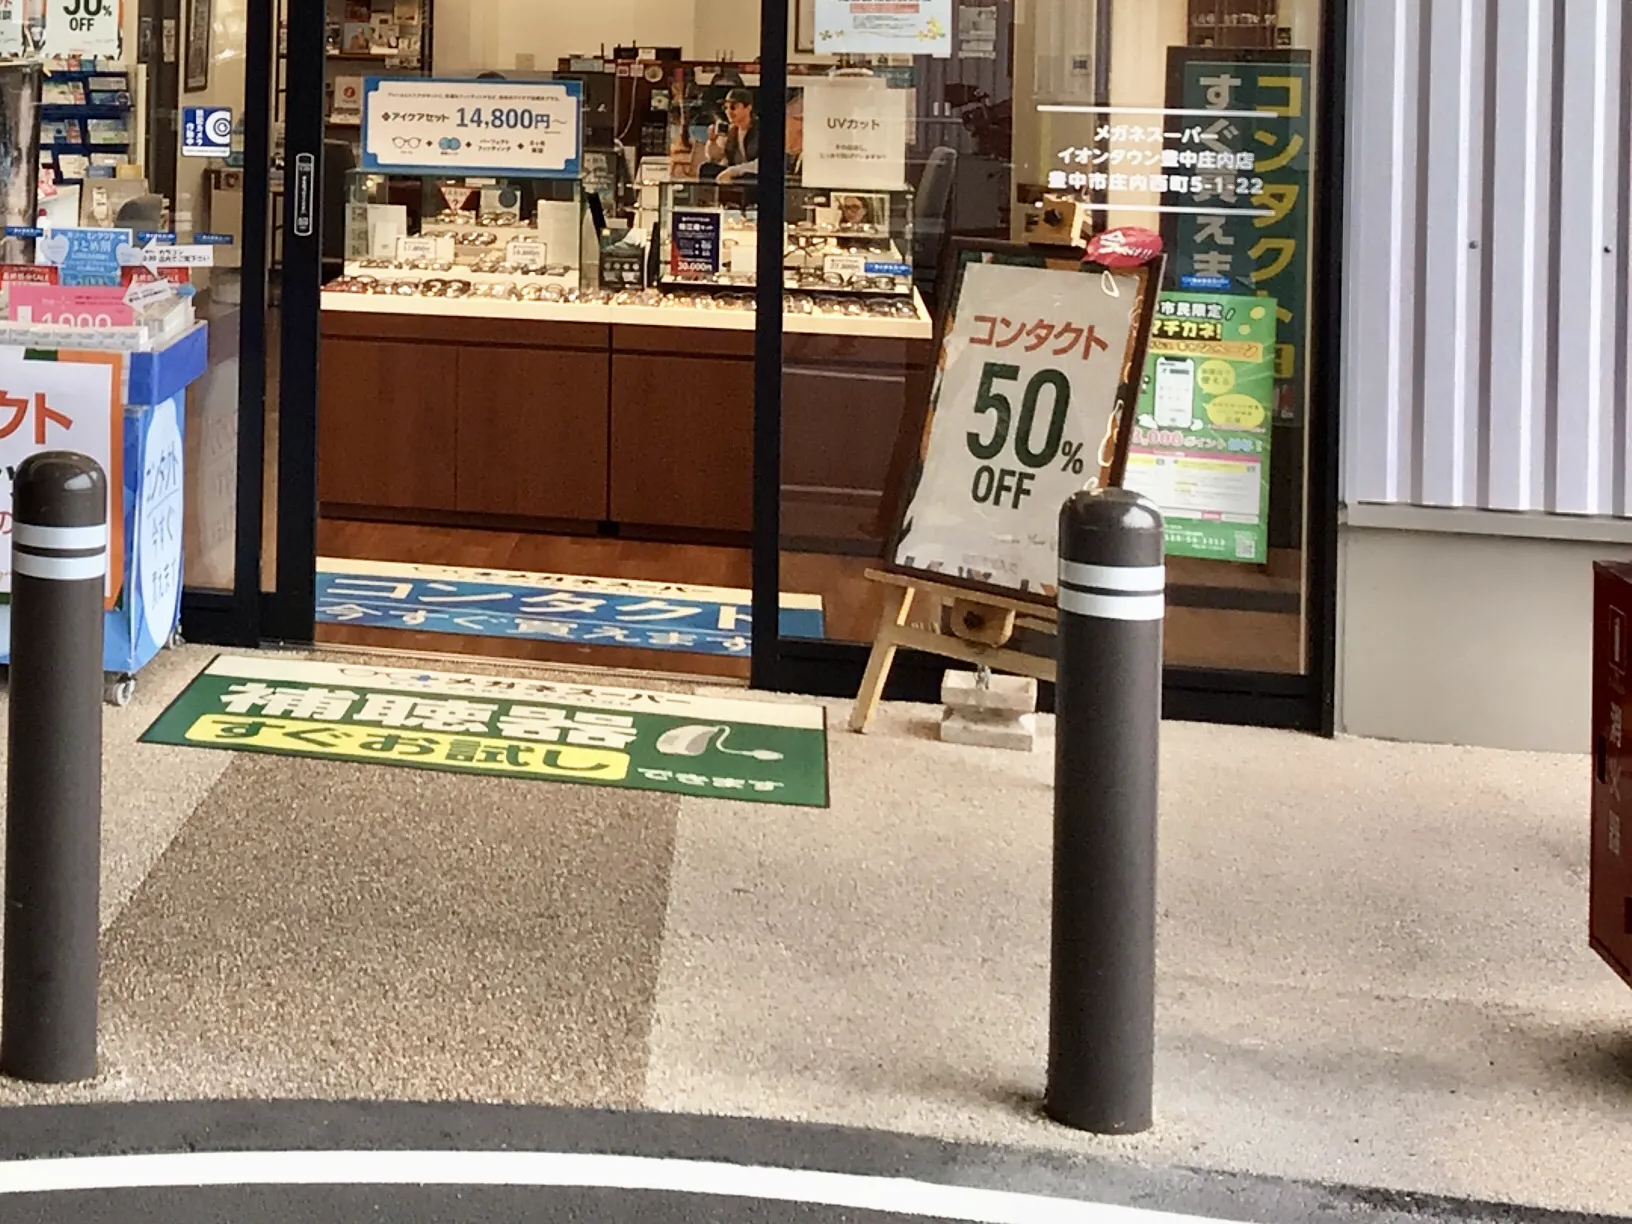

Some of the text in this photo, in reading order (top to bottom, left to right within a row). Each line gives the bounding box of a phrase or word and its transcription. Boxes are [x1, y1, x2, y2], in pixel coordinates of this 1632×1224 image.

[69, 17, 95, 31] OFF
[827, 117, 880, 131] UVカット
[1094, 125, 1219, 144] メガネスーパー
[1057, 147, 1254, 170] イオンタウン豊中庄内店
[1048, 171, 1264, 195] 豊中市庄内西町5-1-22
[969, 314, 1108, 360] コンタクト
[971, 465, 1036, 509] OFF
[328, 578, 752, 630] コンタクト
[317, 603, 752, 654] 今すぐ買えます
[220, 683, 639, 752] 補聴器
[210, 718, 611, 773] すぐお試し
[637, 767, 785, 792] できます
